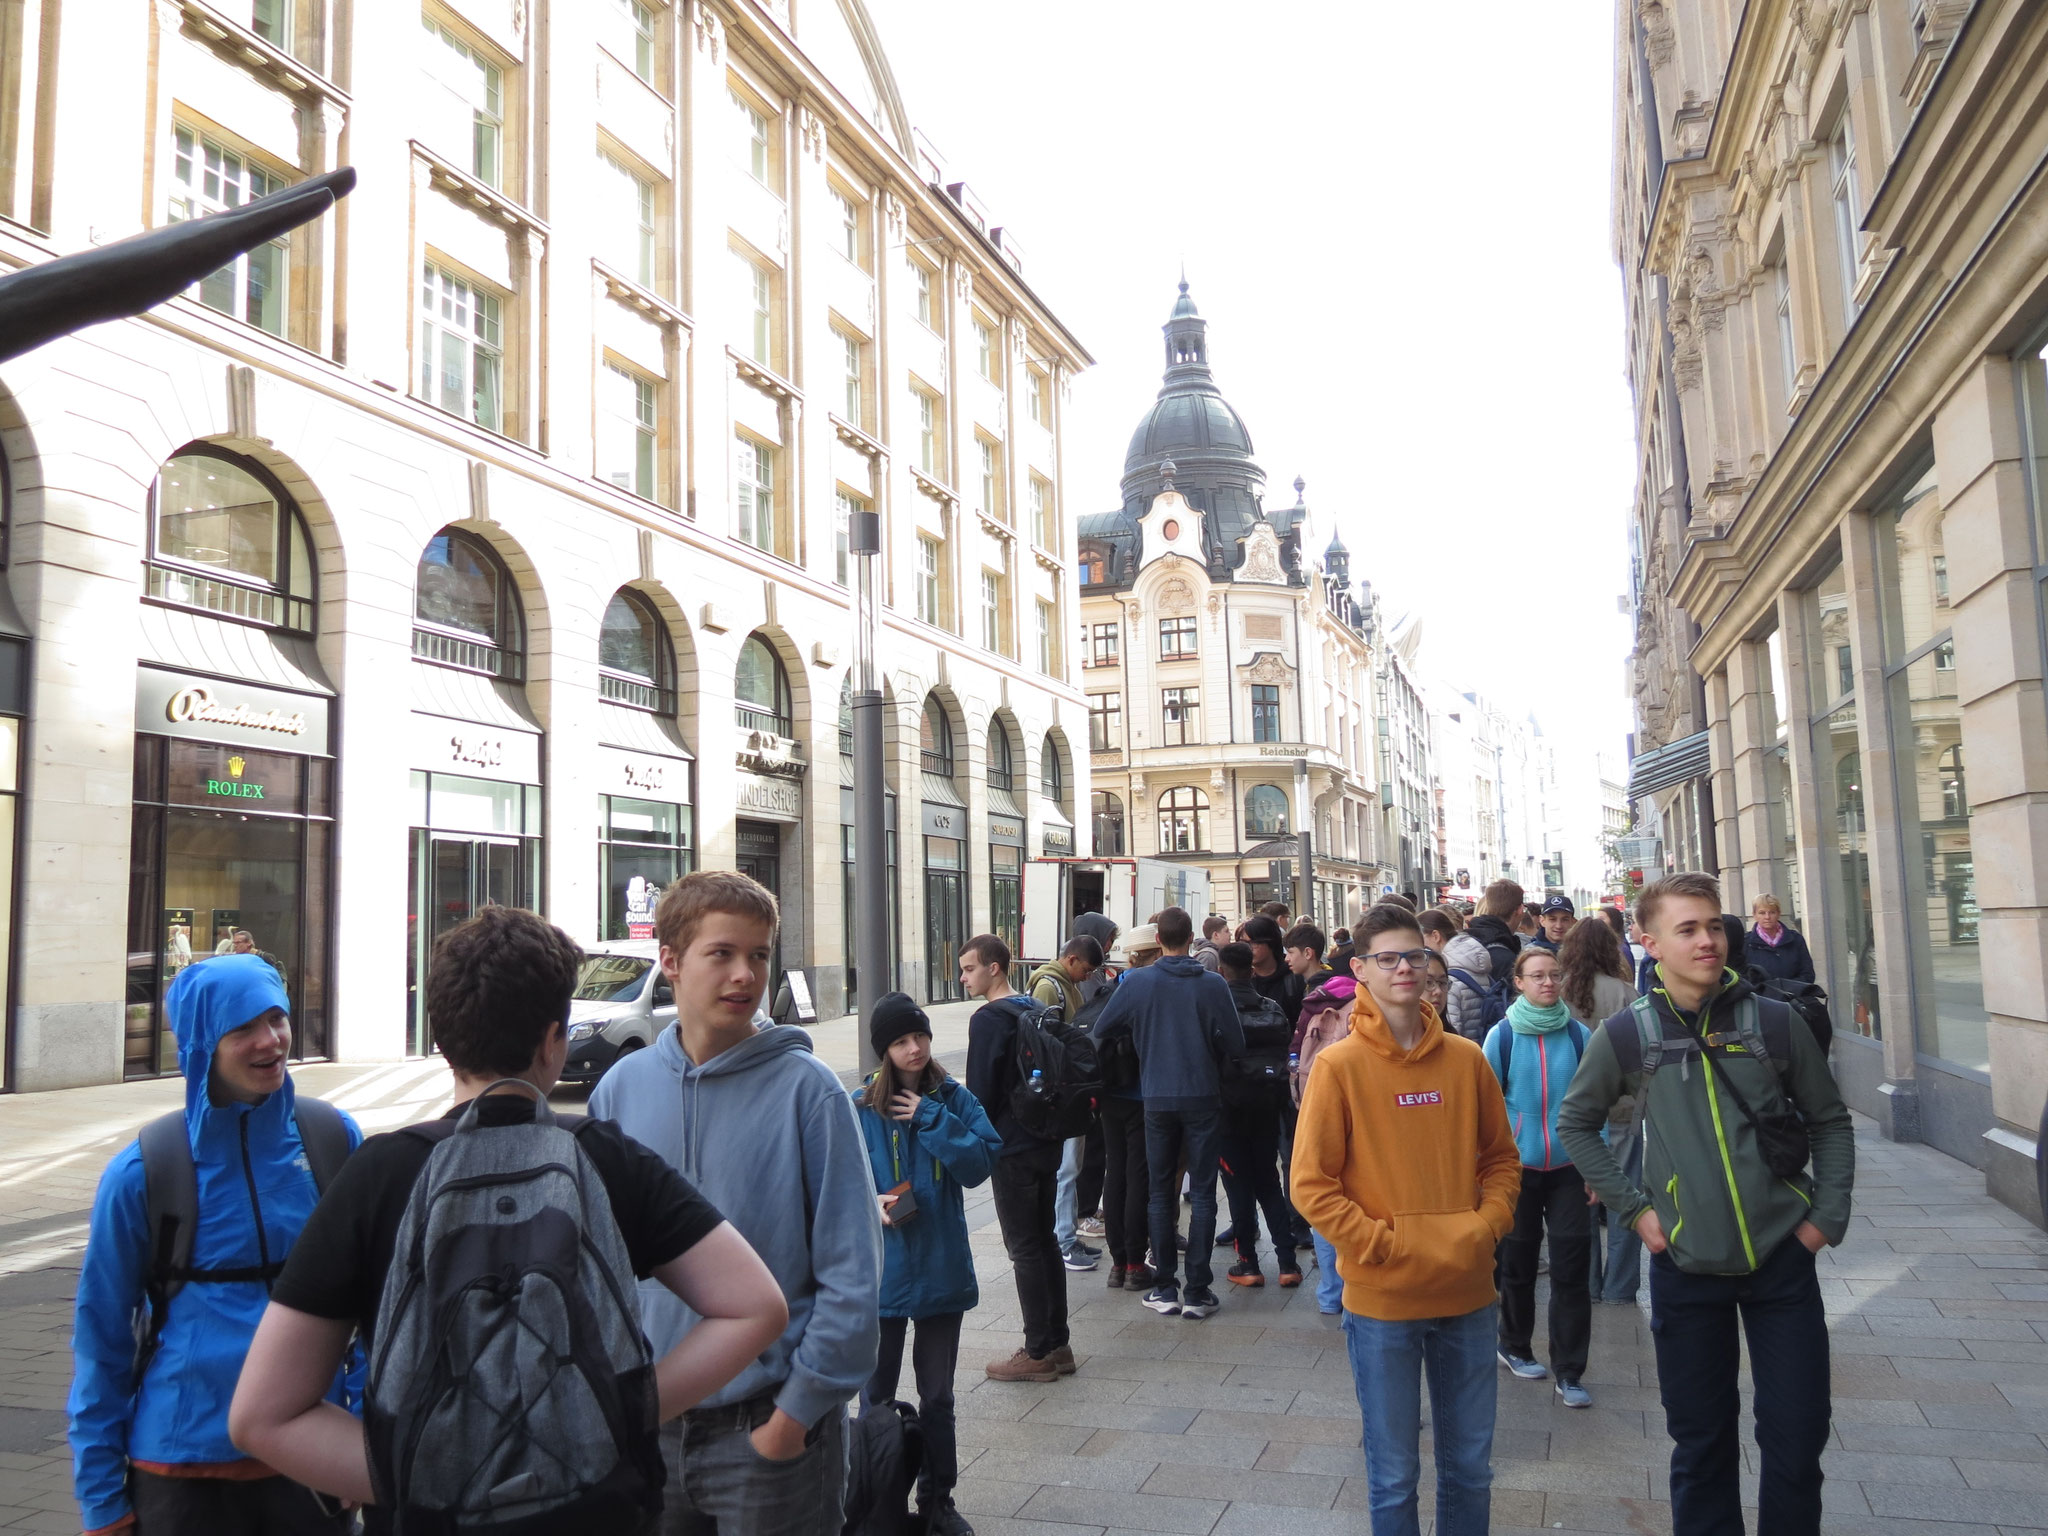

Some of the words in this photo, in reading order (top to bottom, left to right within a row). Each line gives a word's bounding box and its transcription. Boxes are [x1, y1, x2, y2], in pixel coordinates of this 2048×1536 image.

[1259, 747, 1309, 757] Reichshof
[208, 780, 264, 799] ROLEX
[736, 781, 798, 812] ANDELSHOF
[935, 813, 951, 829] COS
[1046, 830, 1069, 846] GUESS
[631, 902, 647, 912] can
[626, 908, 655, 923] sound.
[1398, 1091, 1439, 1105] LEVI'S
